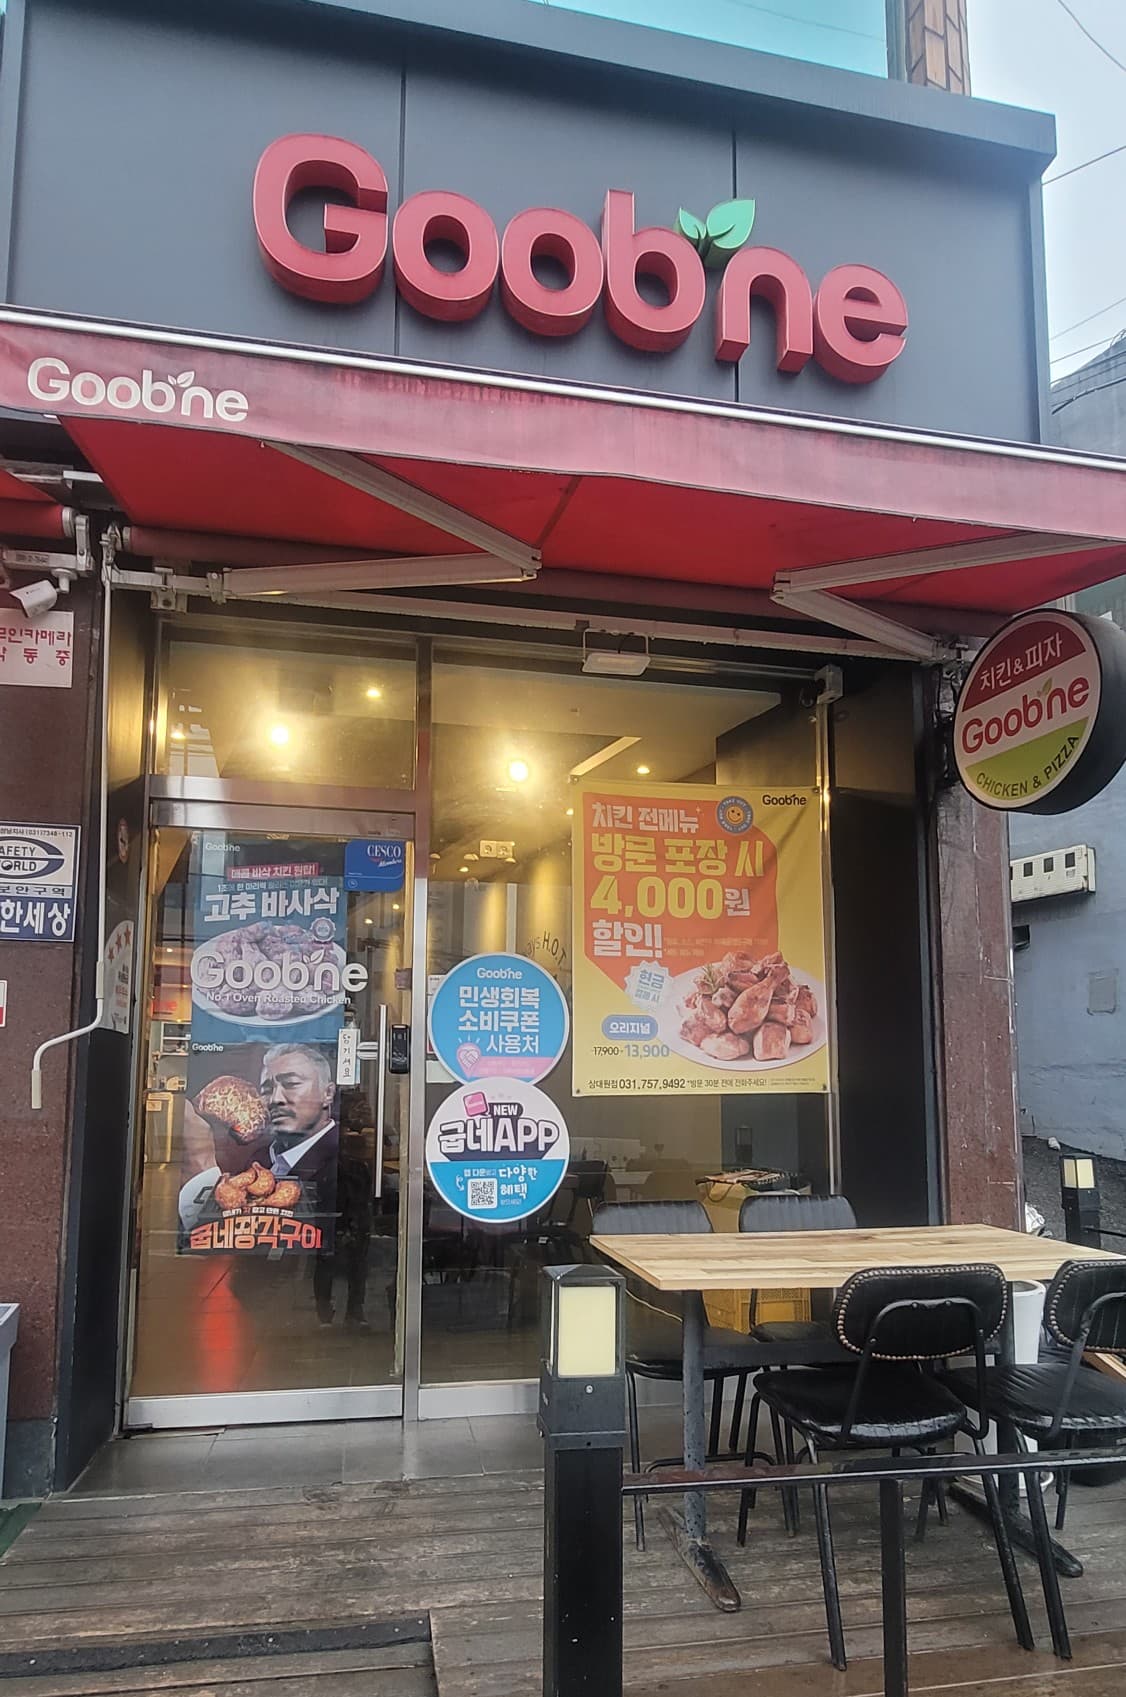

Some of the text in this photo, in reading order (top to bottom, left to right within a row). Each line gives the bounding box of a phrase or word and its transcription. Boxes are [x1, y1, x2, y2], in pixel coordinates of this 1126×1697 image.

[253, 133, 908, 383] Goobne
[27, 357, 249, 422] Goobne
[980, 632, 1063, 691] 치킨&피자
[962, 677, 1090, 754] Goobne
[976, 736, 1080, 797] CHICKEN & PIZZA
[762, 794, 807, 806] Goobne
[592, 801, 632, 829] 치킨
[638, 806, 699, 834] 전메뉴
[367, 845, 401, 858] CESCO
[591, 833, 764, 877] 방문 포장 시
[204, 887, 340, 921] 고추 바사삭
[590, 875, 750, 920] 4,000원
[592, 919, 663, 958] 할인!
[191, 949, 369, 992] Goobne
[476, 967, 523, 980] Goobne
[233, 993, 261, 1003] Oven
[263, 993, 306, 1003] Roasted
[309, 994, 351, 1005] Chicken
[458, 986, 540, 1009] 민생회복
[458, 1010, 540, 1032] 소비쿠폰
[609, 1022, 651, 1035] 오리지널
[486, 1034, 539, 1055] 사용처
[624, 1044, 670, 1059] 13,900
[493, 1104, 518, 1116] NEW
[439, 1117, 559, 1154] 굽네APP
[500, 1184, 528, 1199] 혜택
